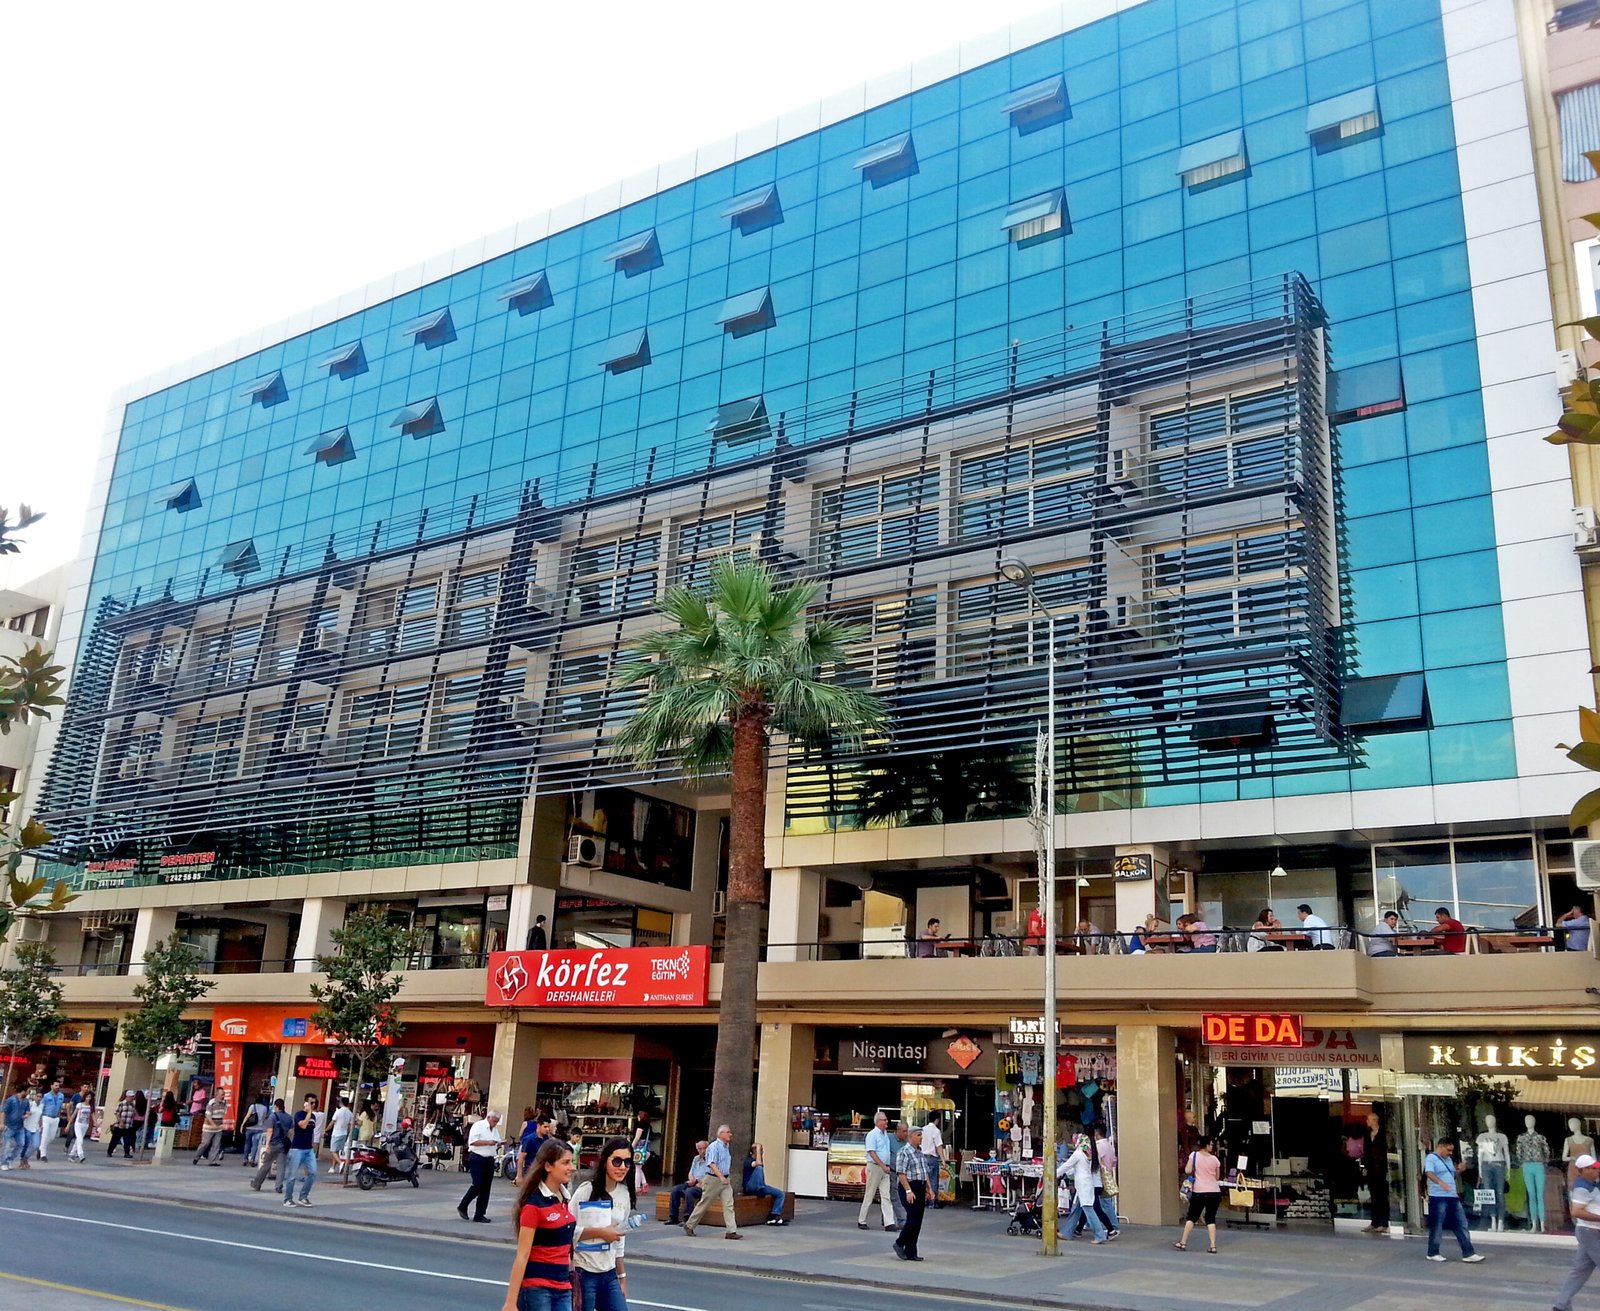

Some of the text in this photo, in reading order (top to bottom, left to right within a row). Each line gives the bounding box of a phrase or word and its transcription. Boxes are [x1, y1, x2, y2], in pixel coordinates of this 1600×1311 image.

[1114, 869, 1147, 877] BALKON
[536, 952, 629, 987] körfez
[546, 989, 617, 1002] DERSHANELERİ
[1010, 1016, 1060, 1033] İLKİ
[1207, 1018, 1298, 1042] DE DA
[852, 1040, 927, 1064] Nişantaşı
[1214, 1051, 1238, 1061] DERİ
[1272, 1052, 1285, 1061] VE
[1288, 1050, 1326, 1062] DÜĞÜN
[1328, 1053, 1382, 1063] SALONLA
[305, 1057, 333, 1068] TÜRK
[297, 1067, 338, 1078] TELEKOM
